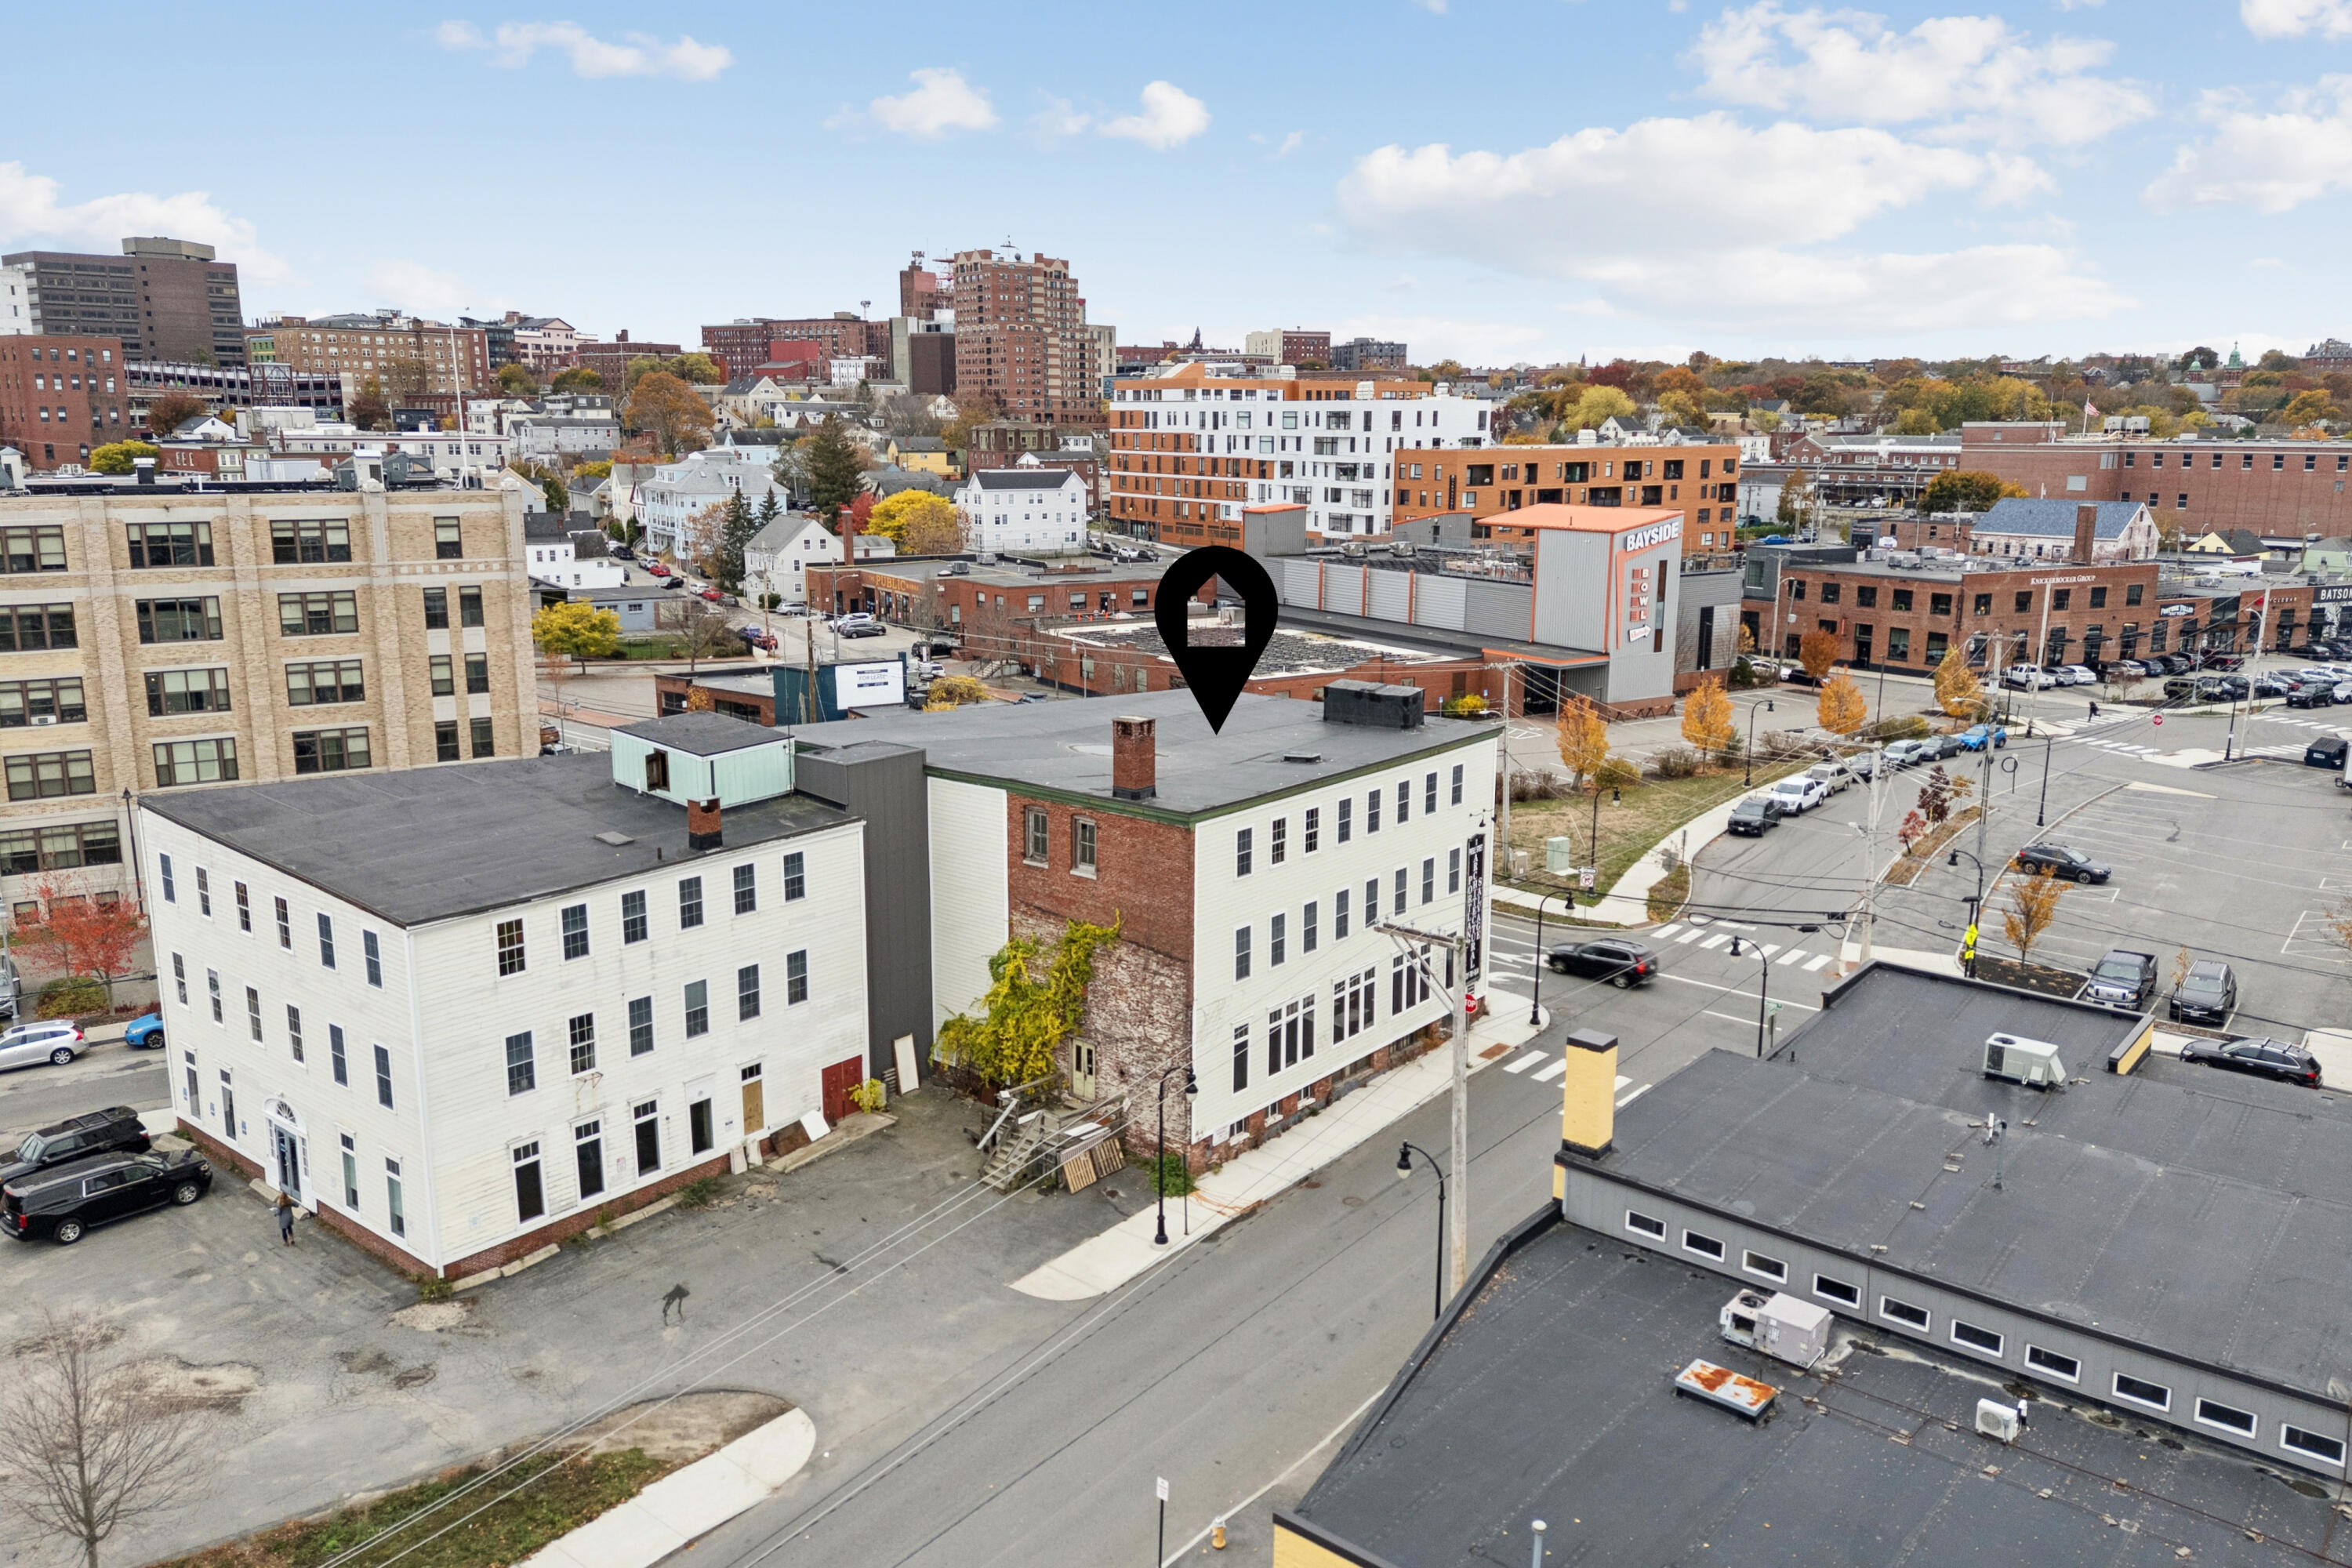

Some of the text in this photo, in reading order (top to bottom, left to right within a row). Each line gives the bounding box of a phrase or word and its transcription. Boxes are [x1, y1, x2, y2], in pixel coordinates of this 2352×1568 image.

[1625, 521, 1679, 552] BAYSIDE
[876, 574, 906, 591] PUBLIC
[1639, 568, 1649, 620] BOWL
